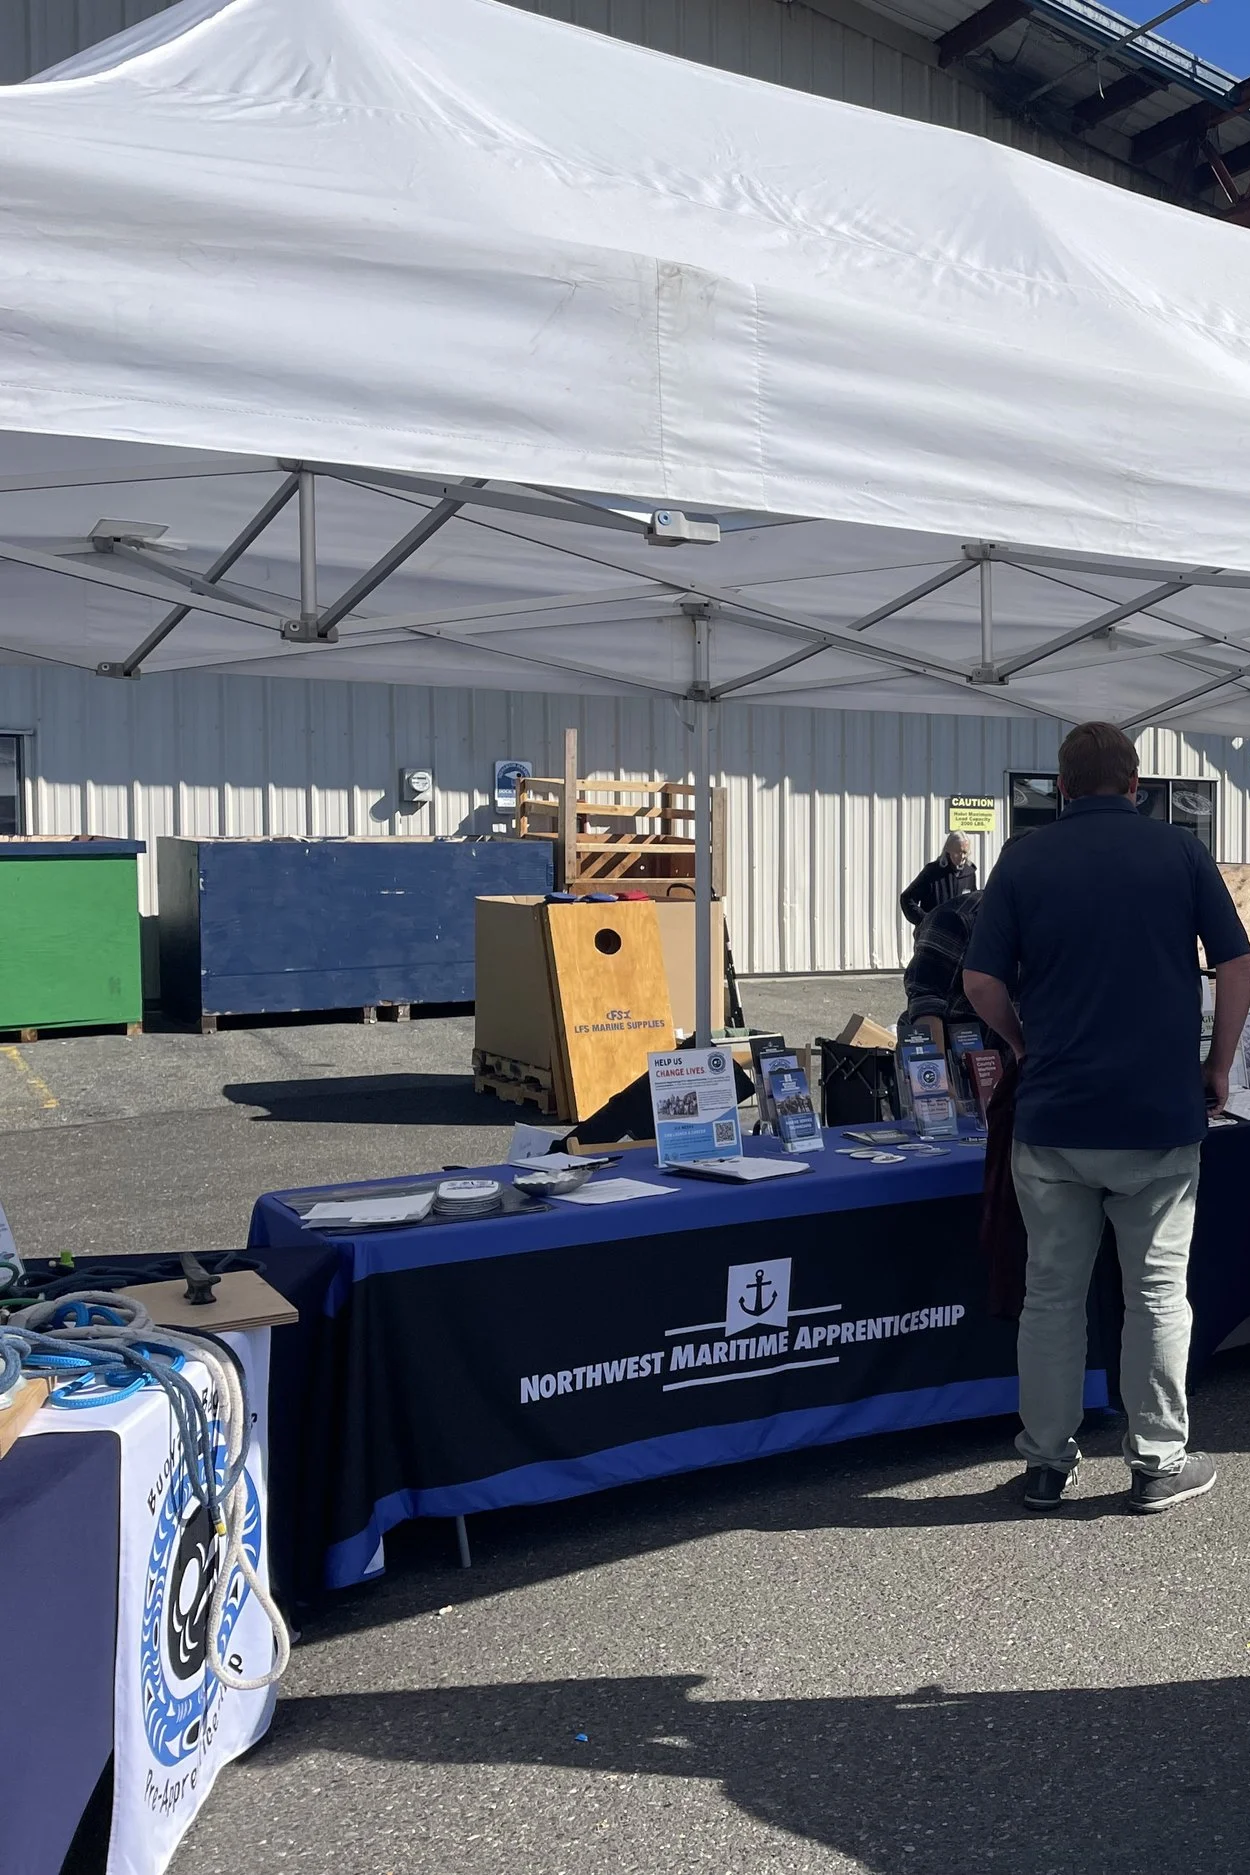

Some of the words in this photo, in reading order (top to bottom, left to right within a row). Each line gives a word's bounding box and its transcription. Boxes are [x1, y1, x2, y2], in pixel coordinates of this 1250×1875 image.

[951, 797, 994, 807] CAUTION
[574, 1024, 590, 1034] LFS
[592, 1022, 625, 1032] MARINE
[627, 1019, 665, 1030] SUPPLIES
[654, 1058, 672, 1067] HELP
[673, 1057, 683, 1066] US
[655, 1068, 685, 1078] CHANGE
[519, 1350, 665, 1404] NORTHWEST
[668, 1330, 789, 1372] MARITIME
[793, 1304, 966, 1351] APPRENTICESHIP
